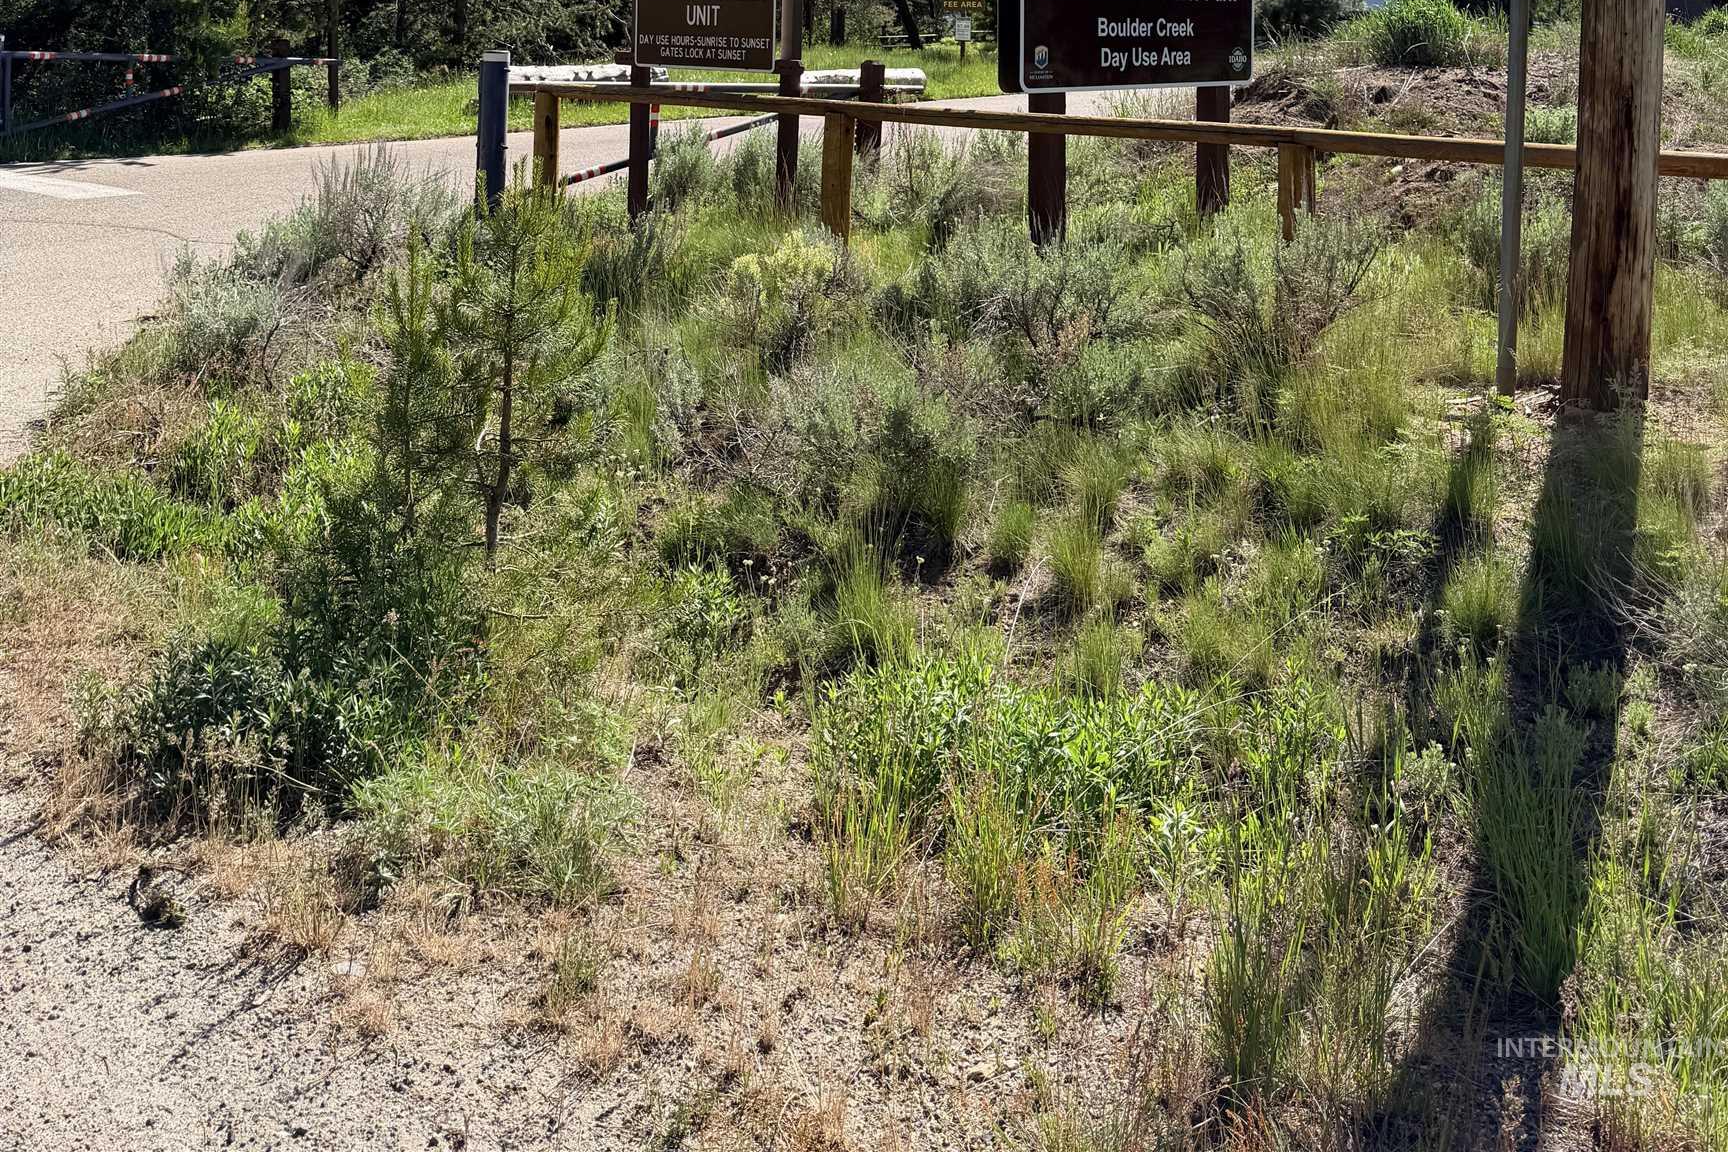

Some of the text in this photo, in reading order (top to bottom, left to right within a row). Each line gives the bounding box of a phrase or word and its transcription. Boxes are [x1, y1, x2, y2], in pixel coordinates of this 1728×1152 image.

[943, 0, 983, 8] FEE AREA
[686, 5, 721, 26] UNIT
[1097, 17, 1194, 37] Boulder Creek
[639, 34, 770, 49] DAY USE HOURS-SUNRISE TO SUNSET
[660, 47, 746, 61] GATES LOCK AT SUNSET
[1100, 47, 1191, 71] Day Use Area
